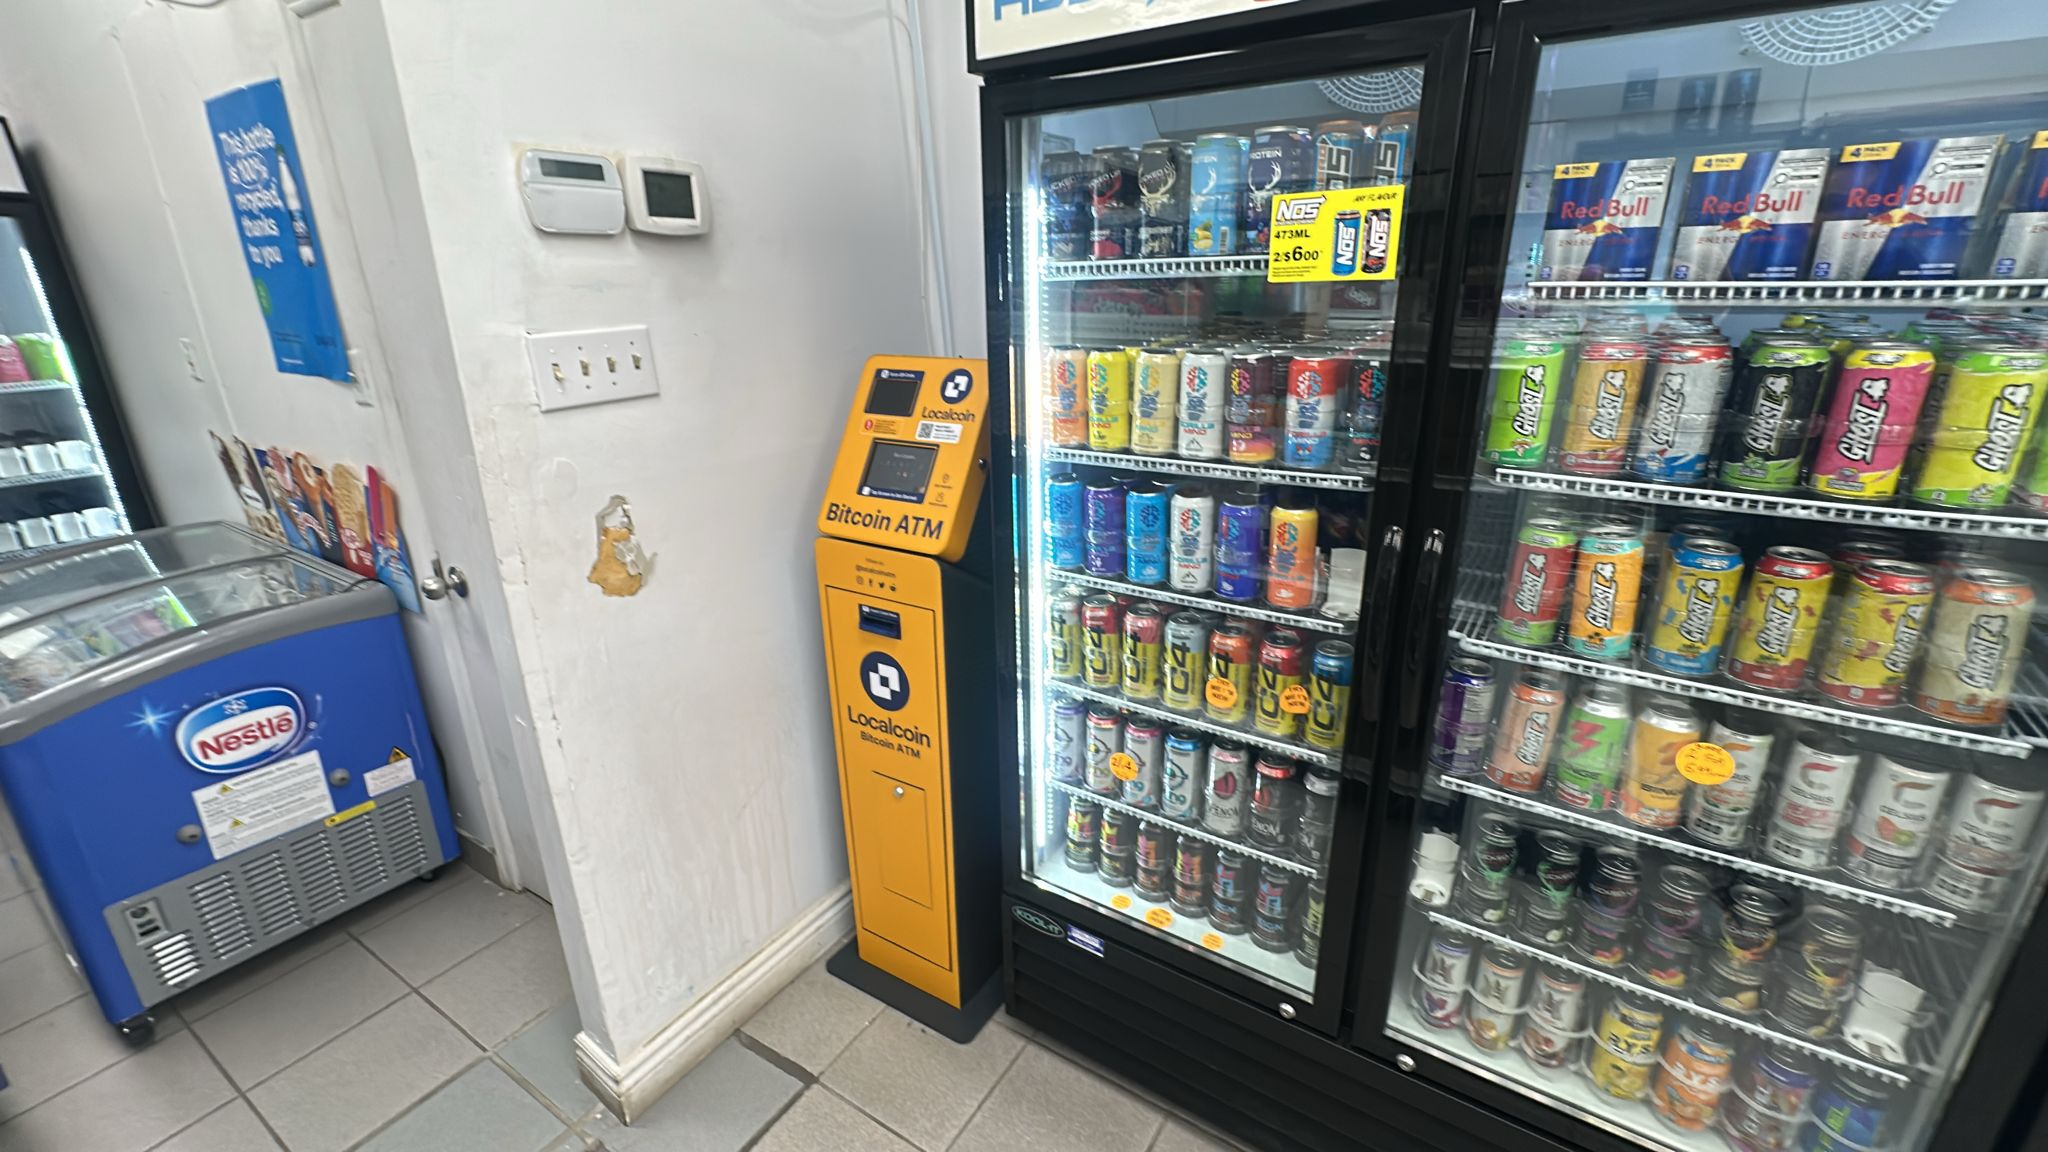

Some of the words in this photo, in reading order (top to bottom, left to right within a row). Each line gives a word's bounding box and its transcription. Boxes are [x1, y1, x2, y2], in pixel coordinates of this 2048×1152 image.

[1561, 165, 1571, 176] 4
[1702, 157, 1714, 168] 4
[1850, 147, 1862, 158] 4
[1276, 197, 1325, 222] NOS
[1561, 198, 1604, 219] Red
[1606, 197, 1650, 218] Bull
[1702, 193, 1752, 216] Red
[1754, 190, 1804, 213] Bull
[1847, 183, 1904, 208] Red
[1905, 181, 1966, 206] Bull
[1274, 229, 1311, 240] 473ML
[1336, 221, 1356, 266] NOS
[1369, 215, 1388, 258] NOS
[921, 406, 976, 423] Localcoin
[1513, 375, 1546, 437] GHOST
[1588, 376, 1627, 440] GHOST
[1650, 388, 1687, 448] GHOST
[1744, 383, 1793, 456] GHOST
[1837, 389, 1888, 465] GHOST
[1973, 395, 2029, 473] GHOST
[826, 501, 891, 531] Bitcoin
[894, 514, 945, 541] ATM
[1514, 562, 1547, 616] GHOST
[1585, 570, 1618, 631] GHOST
[1678, 586, 1719, 645] GHOST
[1756, 594, 1799, 657] GHOST
[1088, 626, 1108, 676] C4
[1169, 641, 1191, 695] C4
[1884, 612, 1922, 674] GHOST
[1956, 622, 2009, 692] GHOST
[1259, 662, 1281, 719] C4
[1312, 672, 1336, 731] C4
[848, 705, 931, 748] Localcoin
[860, 731, 895, 751] Bitcoin
[896, 743, 921, 759] ATM
[1516, 715, 1546, 765] GHOST
